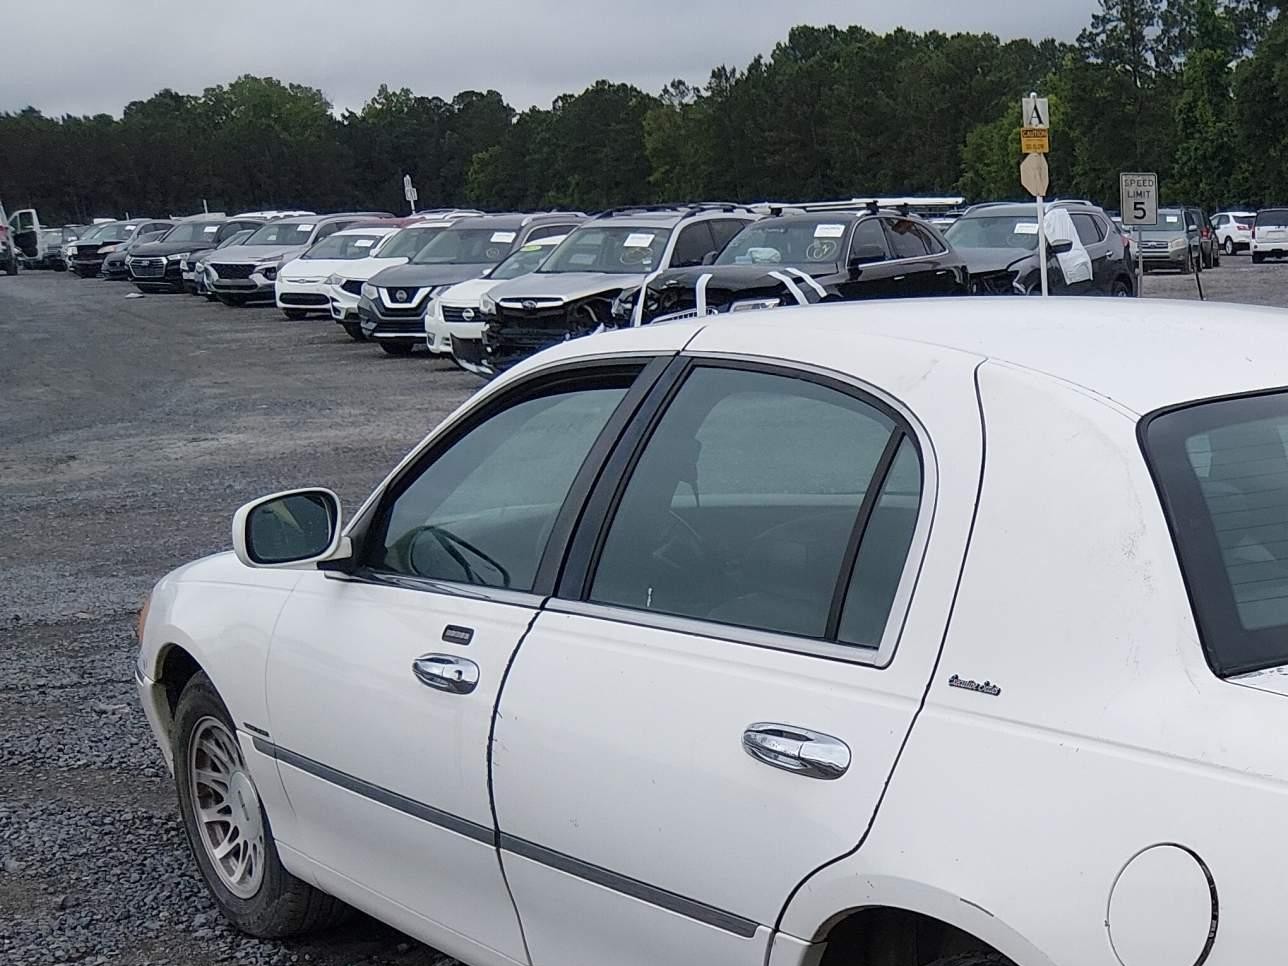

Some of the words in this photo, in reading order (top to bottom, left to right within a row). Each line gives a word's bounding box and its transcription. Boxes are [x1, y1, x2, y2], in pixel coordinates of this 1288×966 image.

[1029, 103, 1044, 125] A
[1124, 179, 1154, 187] SPEED
[1128, 191, 1151, 199] LIMIT
[1134, 202, 1146, 220] 5
